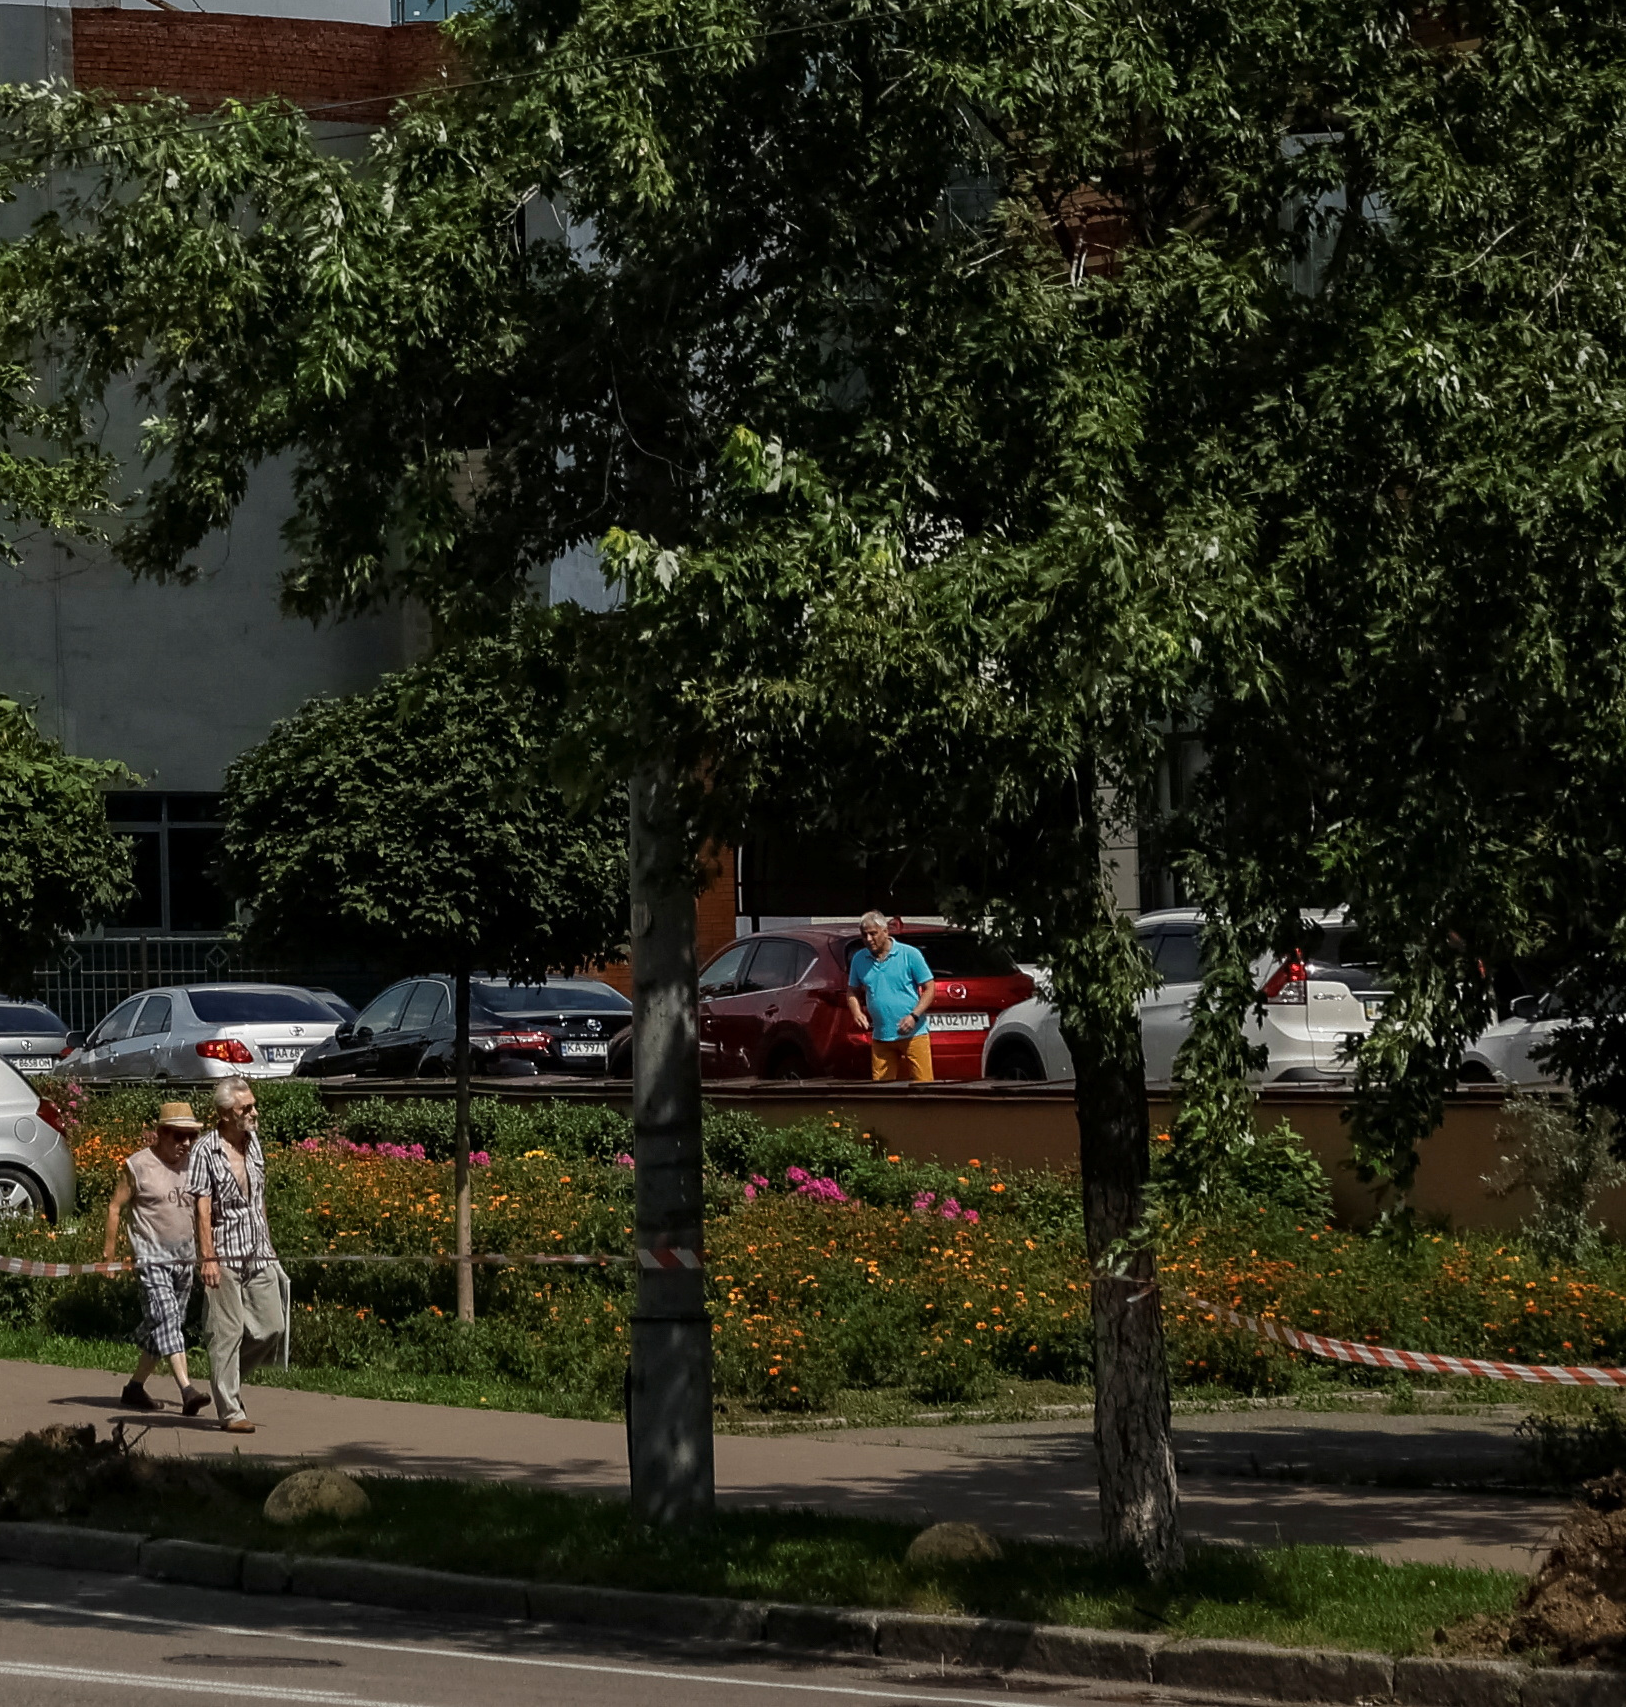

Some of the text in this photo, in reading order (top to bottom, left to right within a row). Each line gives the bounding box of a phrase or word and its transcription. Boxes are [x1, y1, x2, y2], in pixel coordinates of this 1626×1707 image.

[929, 1014, 985, 1026] AA 0217 PT
[275, 1048, 288, 1058] AA
[567, 1043, 606, 1053] KA 9971
